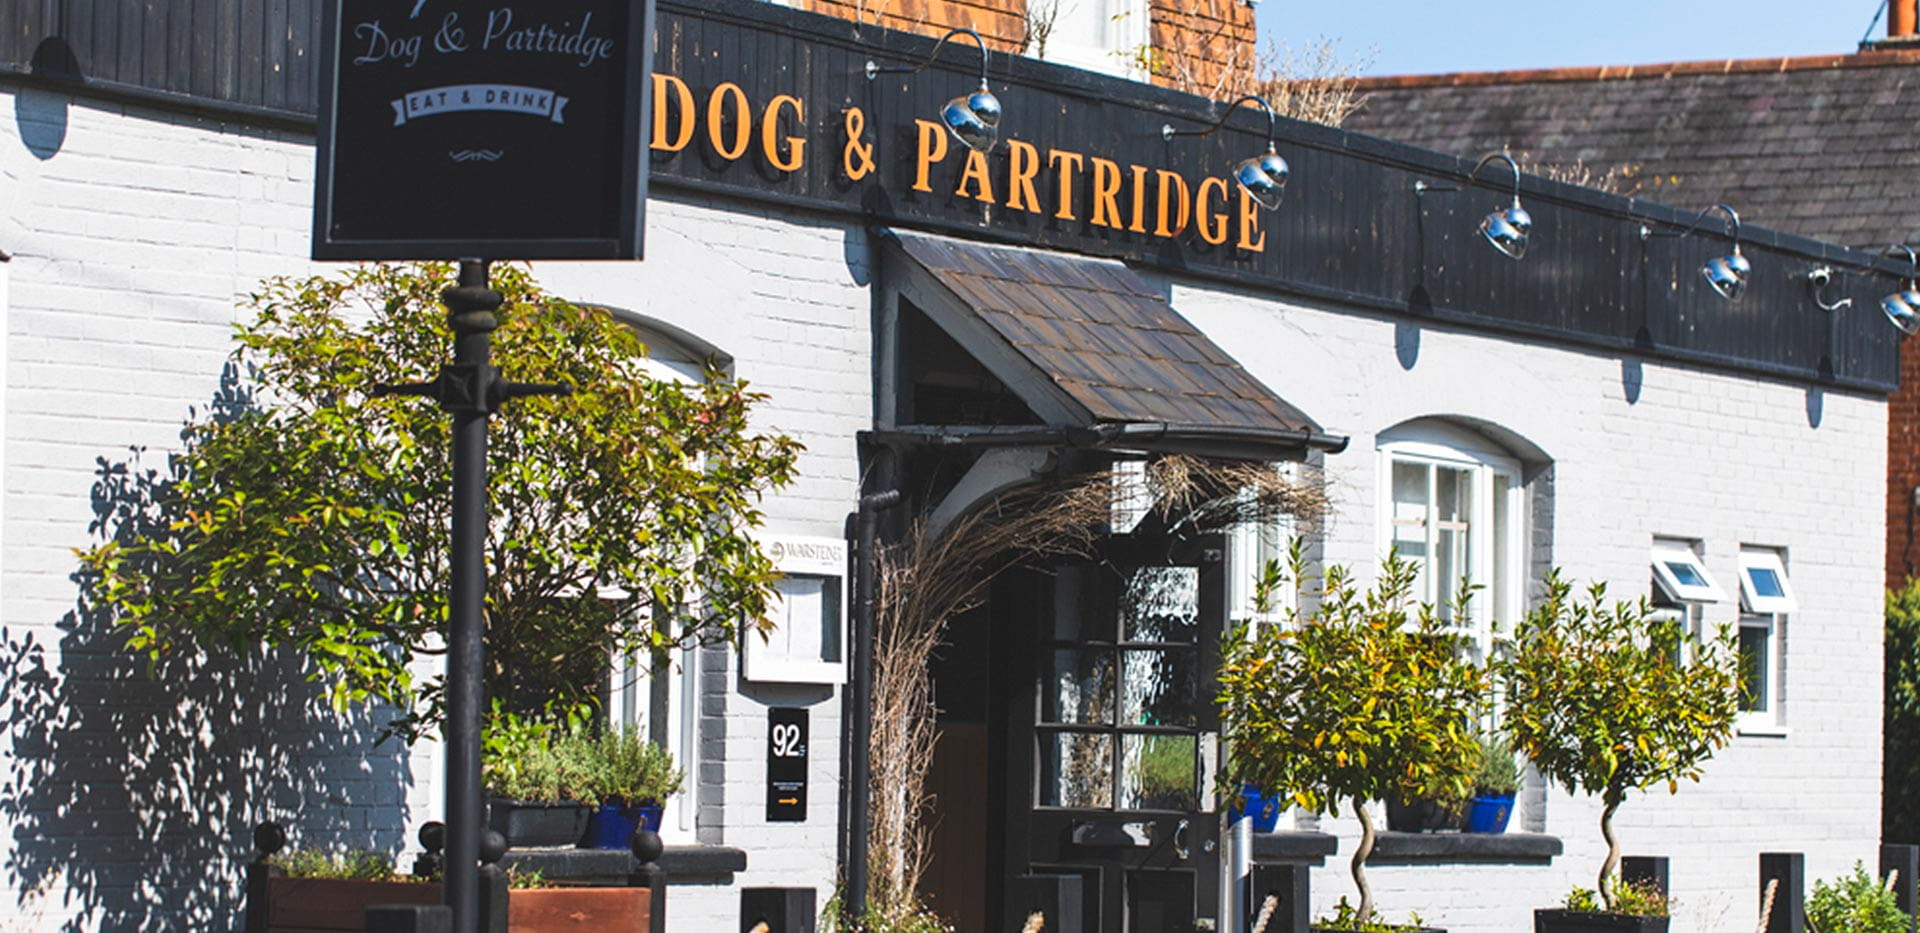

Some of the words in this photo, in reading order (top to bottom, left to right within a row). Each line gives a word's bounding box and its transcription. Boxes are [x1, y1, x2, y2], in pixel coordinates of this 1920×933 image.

[353, 20, 423, 67] Dog
[433, 12, 469, 53] &
[482, 7, 616, 67] Partridge
[410, 92, 448, 112] EAT
[461, 90, 471, 104] &
[485, 91, 549, 109] DRINK
[650, 73, 806, 171] DOG
[843, 106, 876, 181] &
[913, 118, 1267, 253] PARTRIDGE
[773, 724, 800, 757] 92
